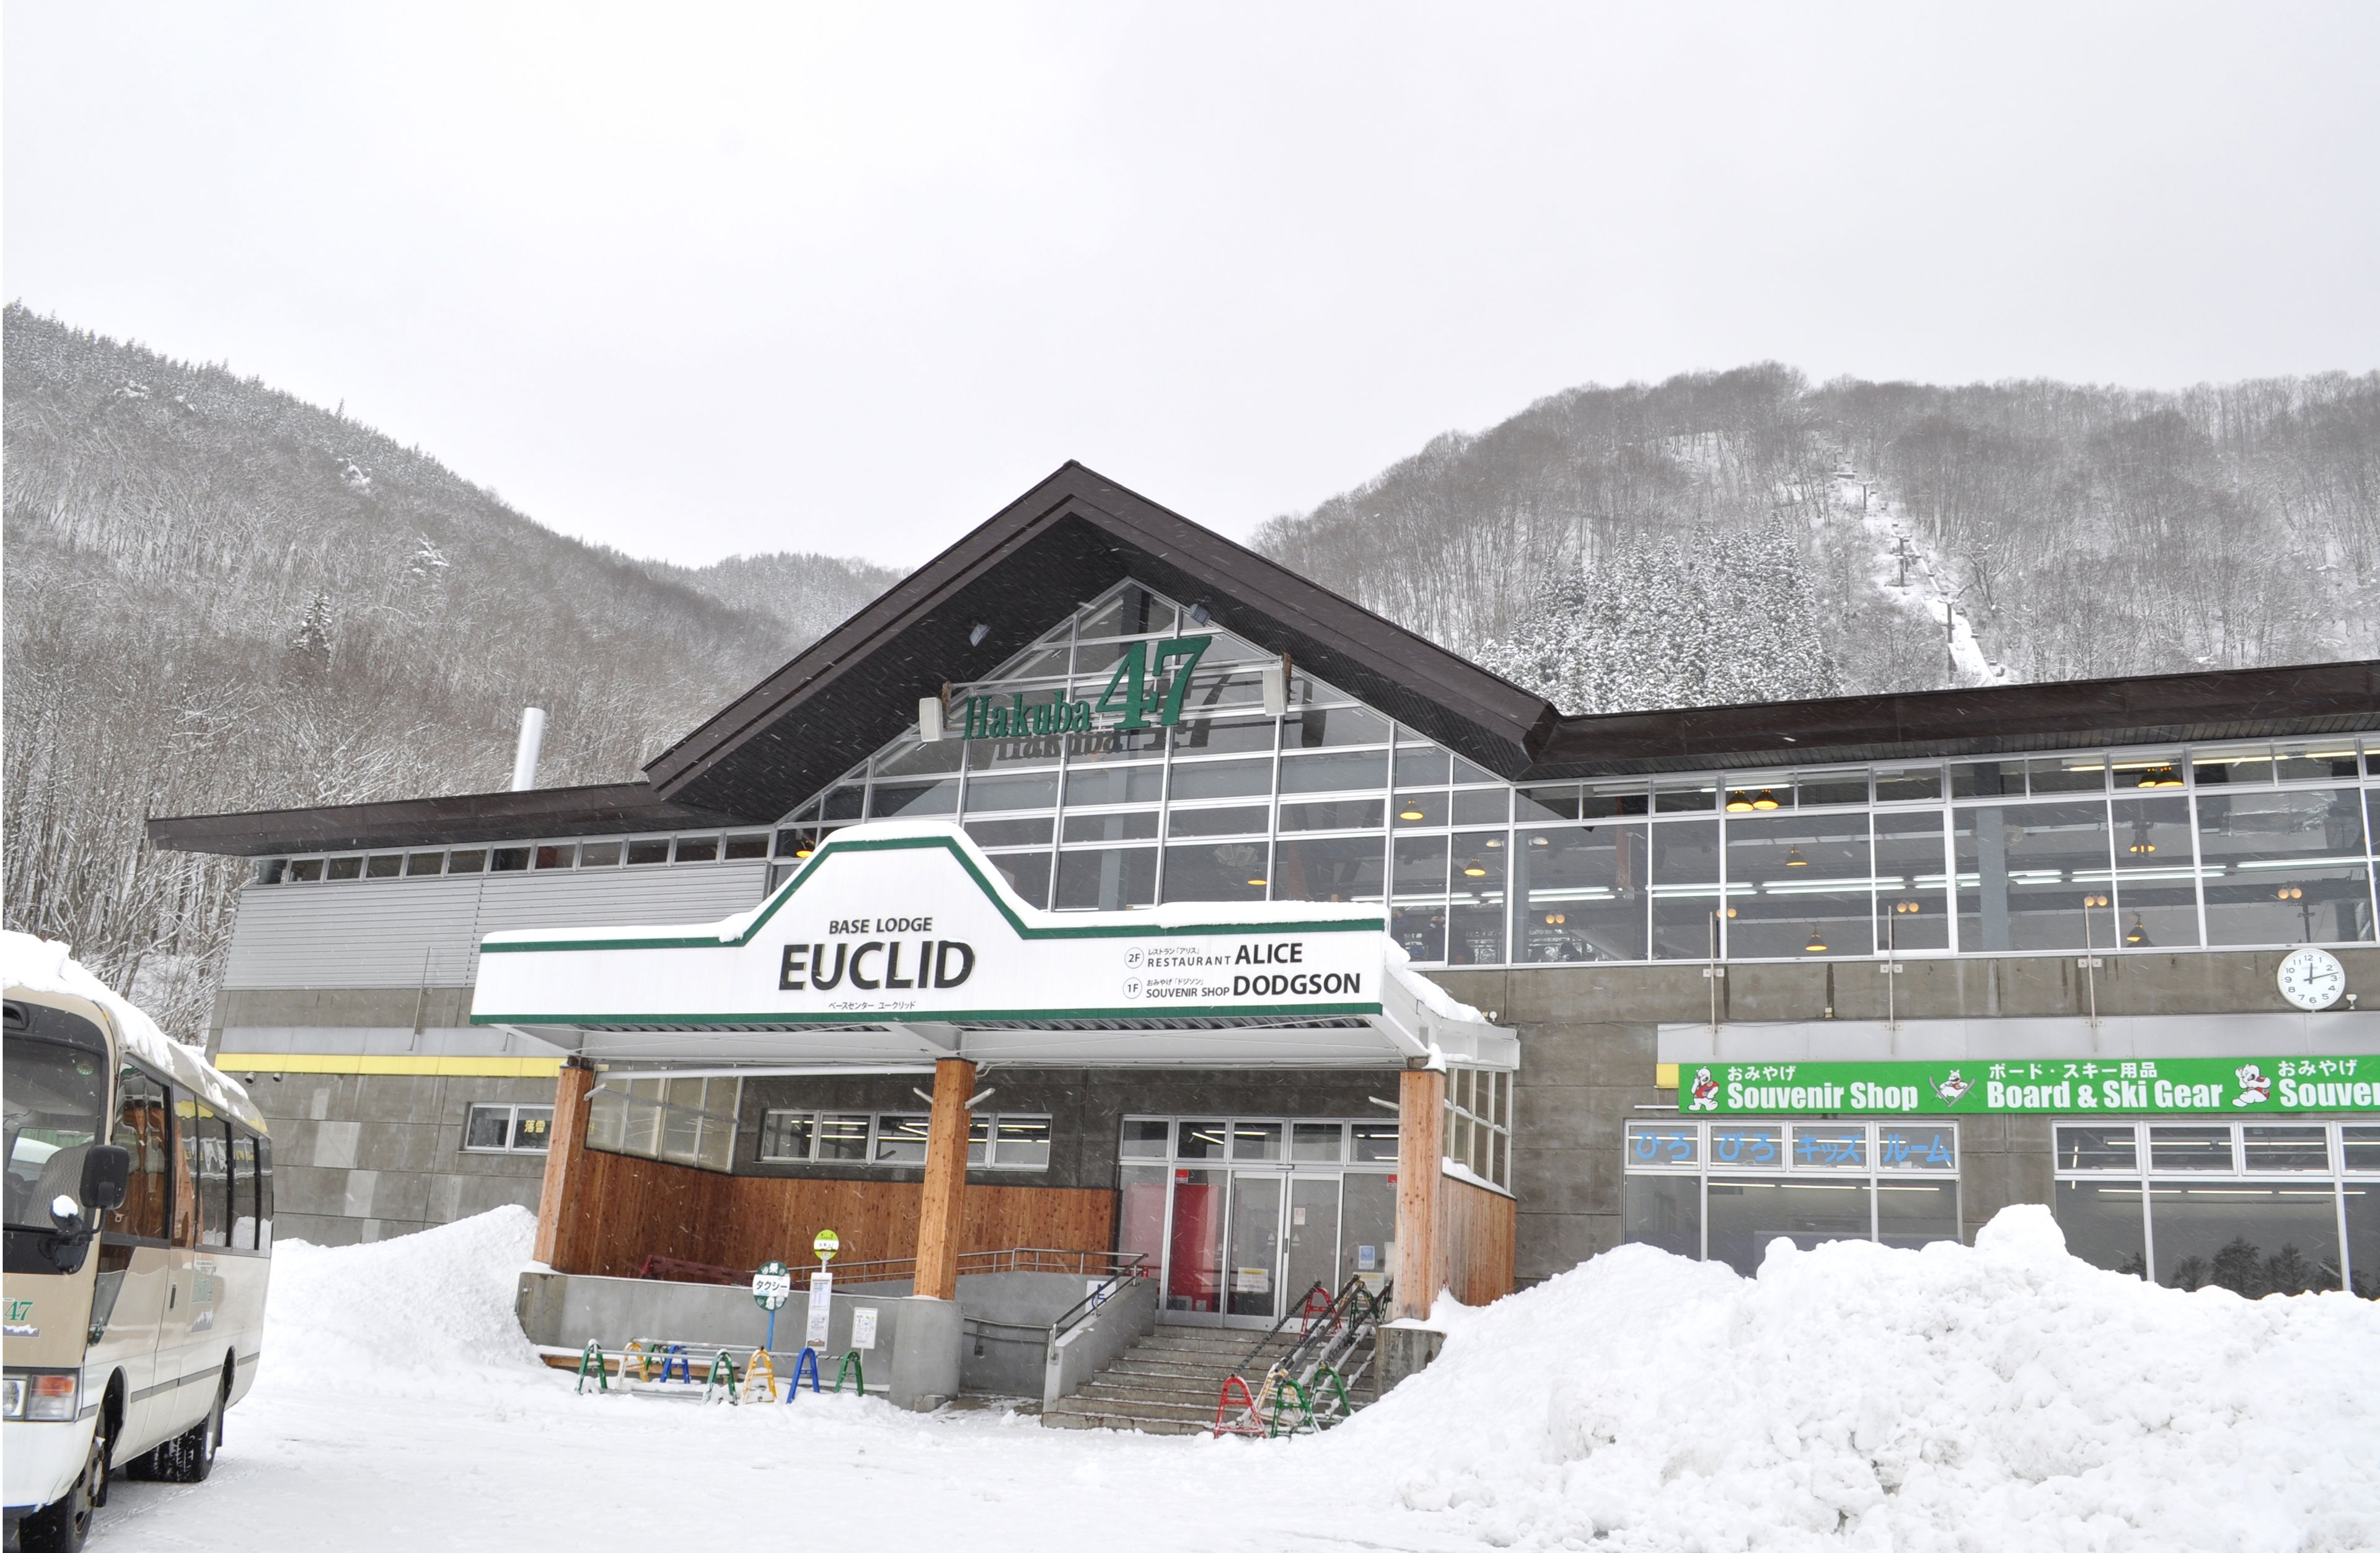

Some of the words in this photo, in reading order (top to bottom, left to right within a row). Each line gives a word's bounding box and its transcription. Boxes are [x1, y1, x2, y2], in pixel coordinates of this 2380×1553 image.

[963, 691, 1091, 739] Hakuba
[1096, 636, 1212, 729] 47
[829, 919, 870, 934] BASE
[876, 917, 933, 932] LODGE
[778, 940, 975, 991] EUCLID
[1128, 953, 1140, 963] 2F
[1147, 955, 1232, 967] RESTAURANT
[1235, 942, 1303, 965] ALICE
[1127, 983, 1139, 993] 1F
[1146, 988, 1197, 998] SOUVENIR
[1201, 987, 1230, 997] SHOP
[1233, 973, 1360, 996] DODGSON
[829, 1002, 874, 1010] ベースセンター
[878, 1001, 916, 1010] ユークリッド
[1727, 1066, 1796, 1082] おみやげ
[1989, 1061, 2157, 1079] ボード・スキー用品
[2278, 1060, 2358, 1077] おみやげ
[1727, 1082, 1844, 1109] Souvenir
[1850, 1081, 1918, 1111] Shop
[1987, 1081, 2071, 1108] Board
[2078, 1084, 2097, 1108] &
[2103, 1079, 2148, 1108] Ski
[2154, 1079, 2223, 1108] Gear
[1797, 1133, 1862, 1162] キッズ
[1884, 1134, 1952, 1163] ルーム
[756, 1280, 788, 1291] タクシー
[4, 1301, 34, 1321] 47
